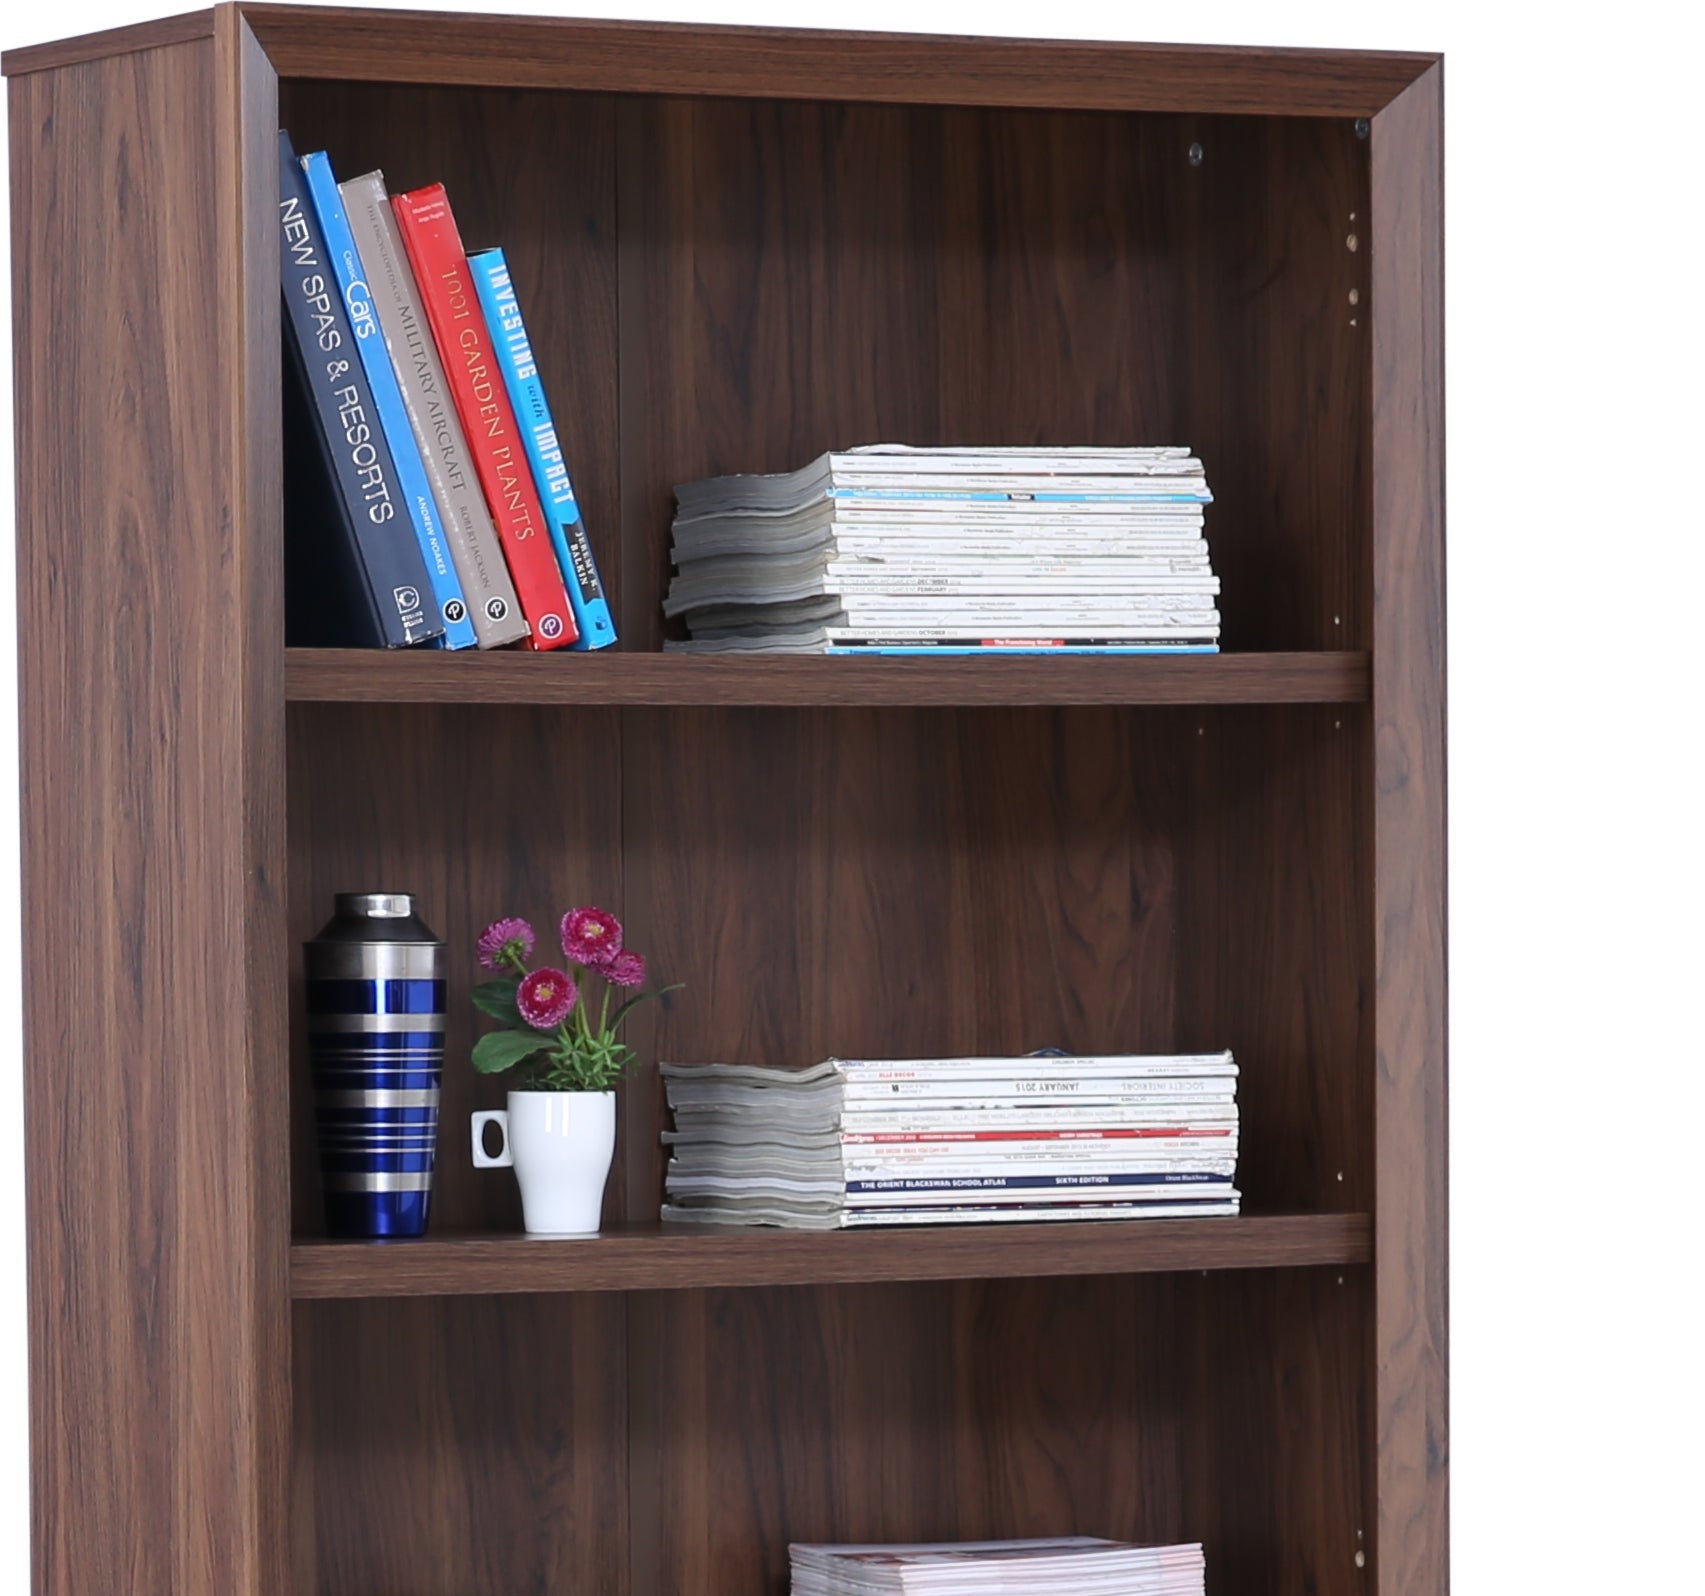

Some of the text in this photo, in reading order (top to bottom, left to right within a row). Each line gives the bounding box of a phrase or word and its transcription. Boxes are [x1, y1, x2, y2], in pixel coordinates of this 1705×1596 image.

[343, 250, 376, 339] Classic Cars
[280, 197, 394, 524] NEW SPAS & RESORTS
[398, 305, 438, 395] MILITARY
[427, 400, 467, 491] AIRCRAFT
[488, 263, 575, 504] INVESTING with IMPACT
[442, 271, 535, 542] 1001 GARDEN PLANTS
[417, 495, 447, 575] ANDREW NOAKES
[460, 506, 490, 588] ROBERT JACKSON
[570, 544, 588, 586] BALKIN
[1015, 1082, 1080, 1092] JANUARY 2015
[1121, 1081, 1204, 1091] SOCIETY INTERIORS
[877, 1181, 904, 1189] ORIENT
[952, 1179, 981, 1187] SCHOOL
[982, 1178, 1006, 1187] ATLAS
[1055, 1176, 1109, 1185] SIXTH EDITION
